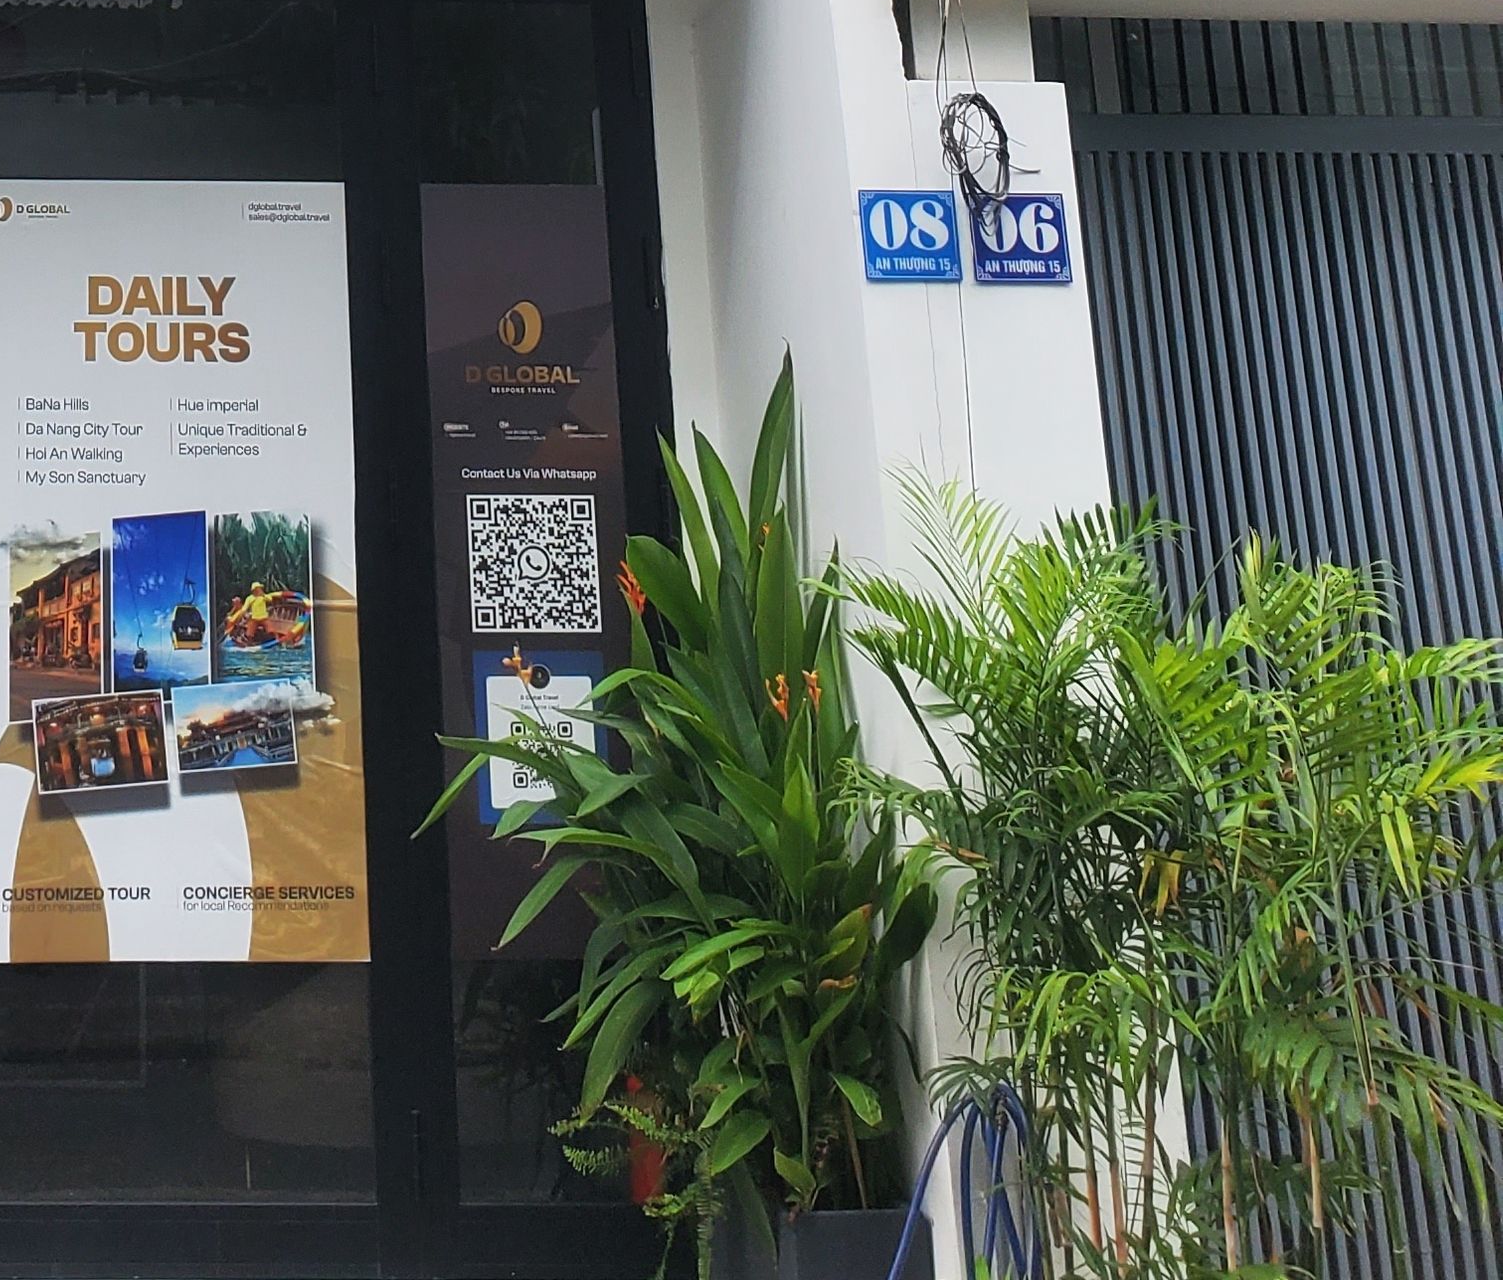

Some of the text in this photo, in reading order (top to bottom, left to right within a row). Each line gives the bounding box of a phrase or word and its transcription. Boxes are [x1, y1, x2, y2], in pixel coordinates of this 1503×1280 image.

[16, 204, 71, 214] D GLOBAL
[869, 199, 949, 250] 08
[979, 201, 1059, 254] 06
[875, 257, 891, 270] AN
[938, 257, 951, 270] 15
[985, 260, 1000, 273] AN
[1048, 260, 1061, 273] 15
[88, 275, 236, 316] DAILY
[73, 321, 251, 362] TOURS
[465, 366, 581, 384] D GLOBAL
[527, 386, 557, 394] TRAVEL
[25, 397, 90, 411] BaNa Hills
[178, 398, 204, 411] Hue
[25, 422, 144, 438] Da Nang City Tour
[178, 423, 307, 438] Unique Traditional &
[25, 447, 123, 463] Hoi An Walking
[178, 442, 260, 458] Experiences
[25, 470, 146, 486] My Son Sanctuary
[461, 468, 597, 481] Contact Us Via Whatsapp
[2, 887, 151, 901] CUSTOMIZED TOUR
[183, 886, 355, 900] CONCIERGE SERVICES
[53, 903, 102, 914] requests
[183, 901, 329, 911] for local Recommendations
